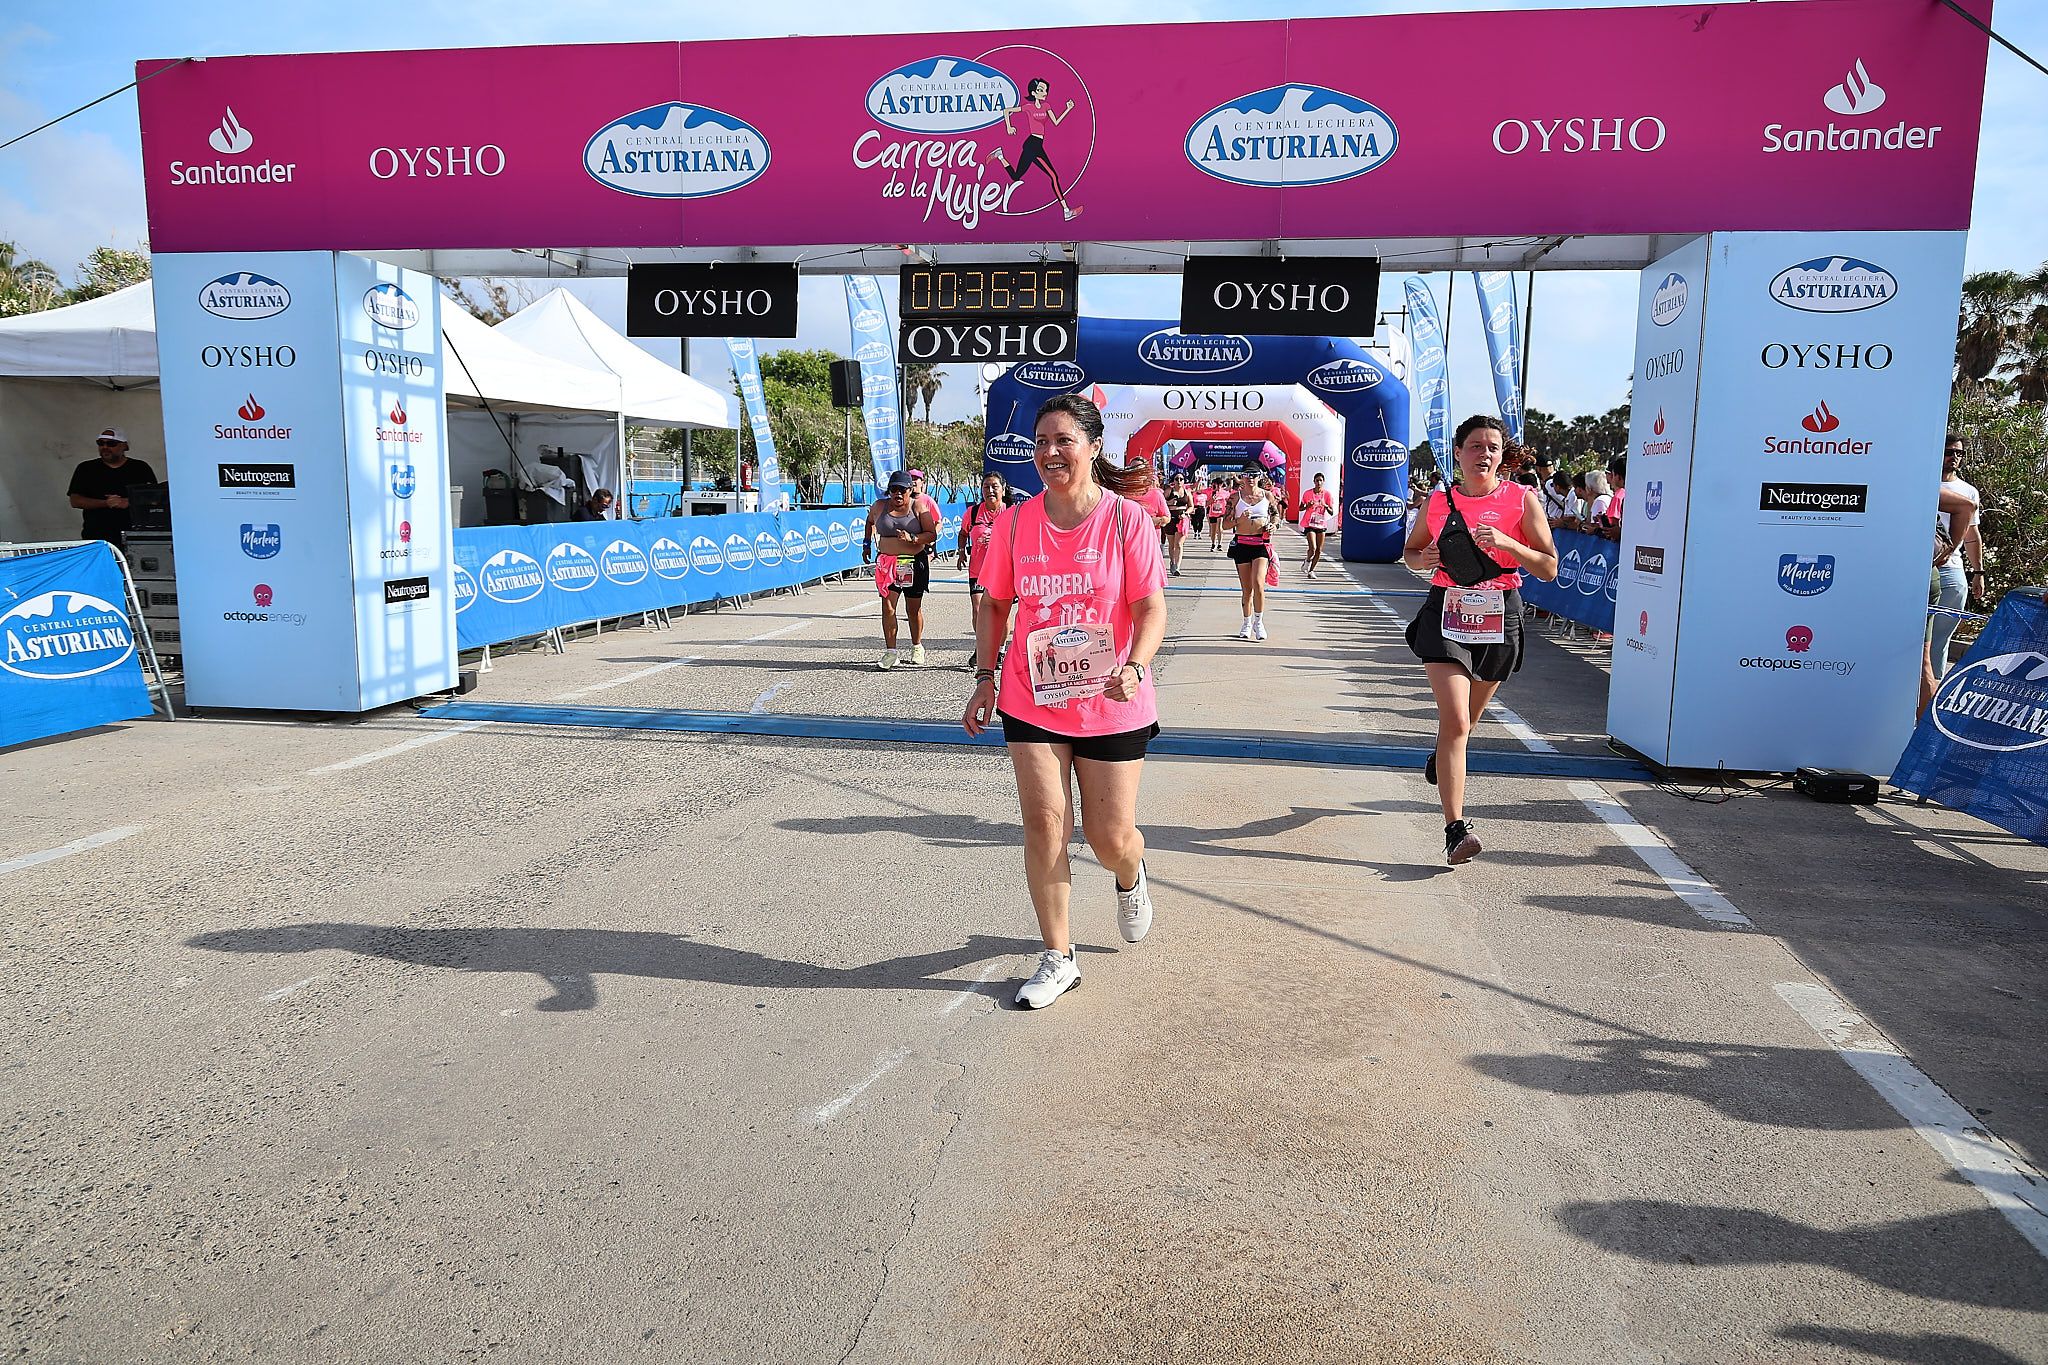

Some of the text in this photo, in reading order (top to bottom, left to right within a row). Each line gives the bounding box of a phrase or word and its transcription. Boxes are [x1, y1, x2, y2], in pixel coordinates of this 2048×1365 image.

[901, 81, 1003, 92] CENTRAL LECHERA
[877, 86, 1007, 115] ASTURIANA
[1234, 118, 1375, 131] CENTRAL LECHERA
[626, 134, 750, 146] CENTRAL LECHERA
[1200, 124, 1381, 161] ASTURIANA
[1492, 116, 1667, 155] OYSHO
[1762, 121, 1942, 153] Santander
[598, 139, 756, 174] ASTURIANA
[852, 129, 978, 169] Carrera
[369, 144, 506, 179] OYSHO
[170, 159, 296, 185] Santander
[882, 164, 1025, 230] de la Mujer
[912, 270, 1064, 310] 00:36:36
[1213, 281, 1350, 313] OYSHO
[1777, 276, 1887, 299] ASTURIANA
[206, 290, 285, 308] ASTURIANA
[368, 295, 416, 322] ASTURIANA
[654, 289, 773, 316] OYSHO
[1653, 294, 1685, 318] ASTURIANA
[907, 323, 1068, 358] OYSHO
[1146, 339, 1244, 361] ASTURIANA
[201, 345, 296, 368] OYSHO
[365, 349, 423, 377] OYSHO
[1645, 348, 1684, 381] OYSHO
[1761, 343, 1893, 370] OYSHO
[1018, 368, 1079, 383] ASTURIANA
[1313, 372, 1379, 385] ASTURIANA
[1163, 389, 1264, 411] OYSHO
[1103, 412, 1134, 420] OYSHO
[1176, 420, 1264, 429] Sports Santander
[1292, 412, 1323, 420] OYSHO
[214, 425, 292, 440] Santander
[376, 427, 423, 444] Santander
[988, 443, 1035, 458] ASTURIANA
[1642, 440, 1674, 457] Santander
[1763, 436, 1873, 455] Santander
[1307, 455, 1336, 463] OYSHO
[223, 468, 291, 486] Neutrogena
[1767, 488, 1860, 509] Neutrogena
[242, 531, 279, 550] Marlene
[606, 558, 646, 575] ASTURIANA
[1020, 554, 1049, 564] OYSHO
[1635, 550, 1663, 571] Neutrogena
[487, 571, 542, 593] ASTURIANA
[552, 565, 596, 582] ASTURIANA
[1781, 562, 1831, 586] Marlene
[386, 583, 428, 600] Neutrogena
[1021, 572, 1094, 596] CARRERA
[23, 615, 119, 634] CENTRAL LECHERA
[223, 611, 307, 627] octopus energy
[1461, 613, 1485, 624] 016
[6, 627, 130, 664] ASTURIANA
[1055, 634, 1087, 646] ASTURIANA
[1058, 658, 1090, 674] 016
[1739, 656, 1856, 676] octopus energy
[1044, 689, 1070, 700] OYSHO
[1972, 676, 2016, 695] CENTRAL
